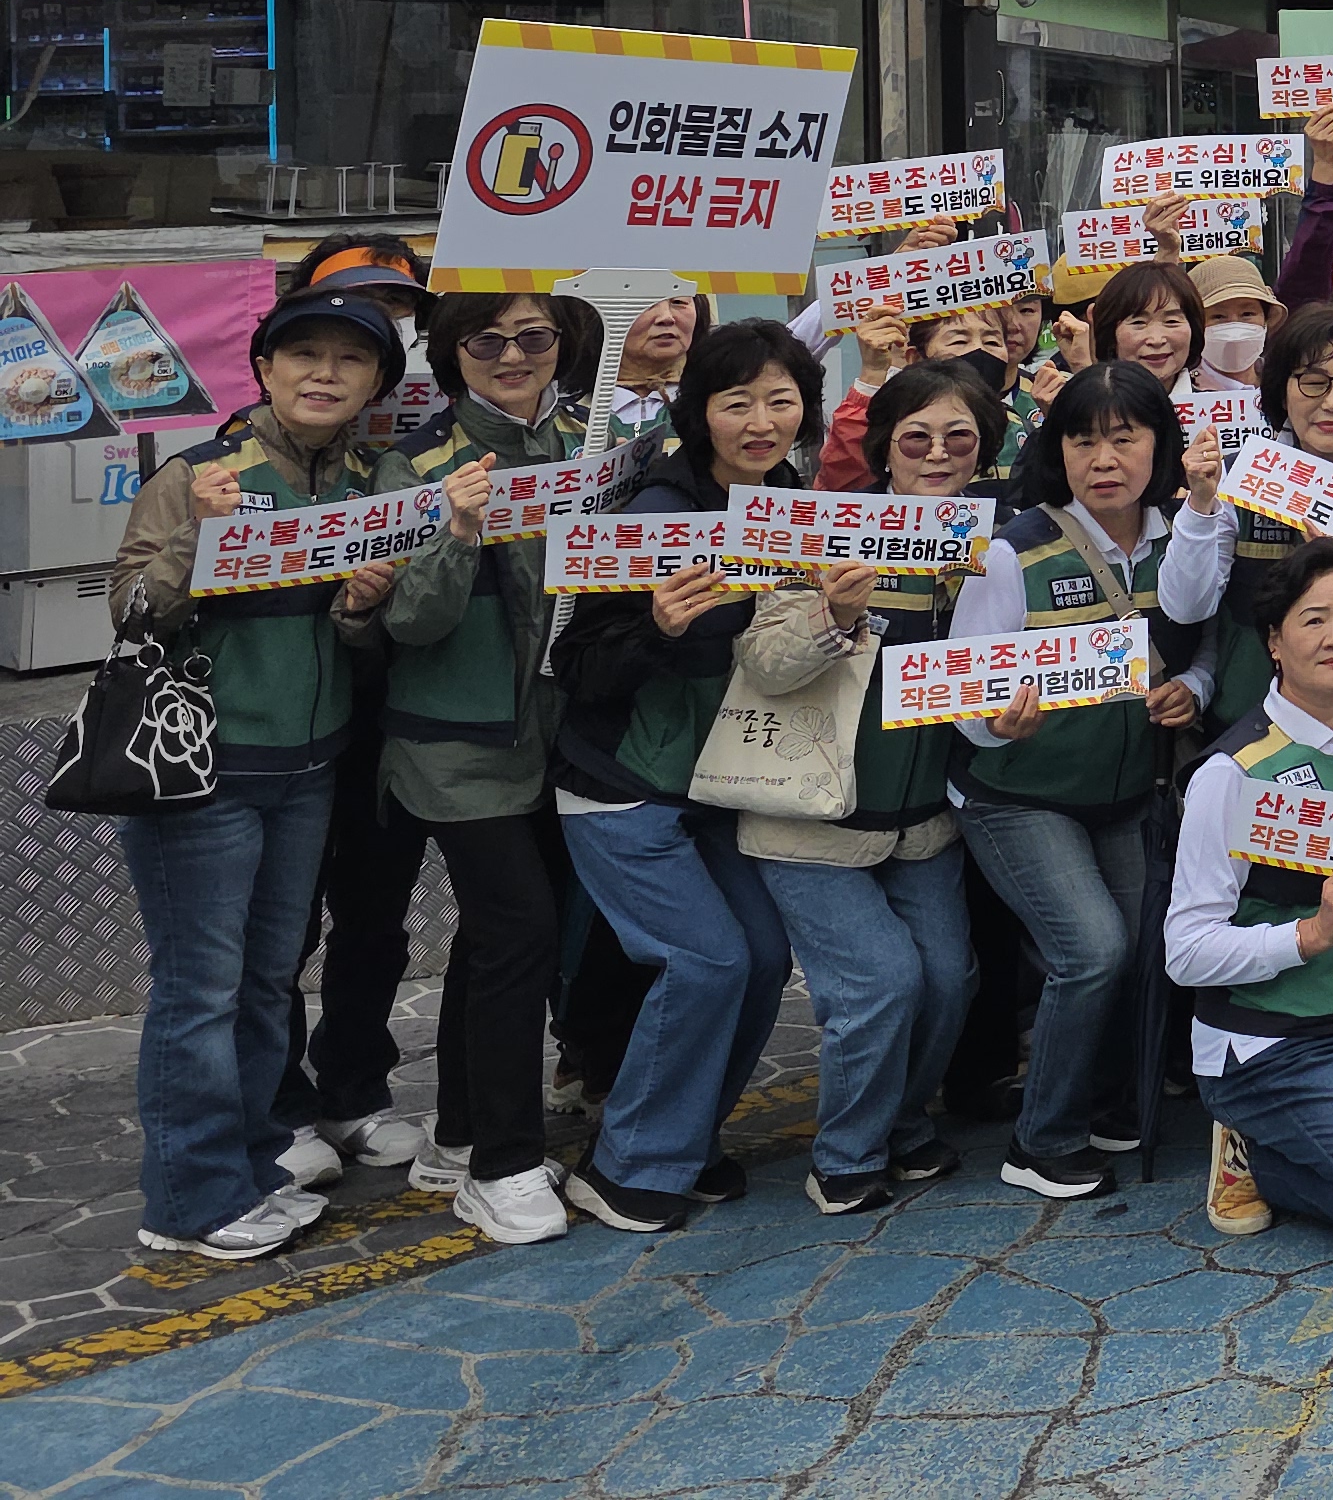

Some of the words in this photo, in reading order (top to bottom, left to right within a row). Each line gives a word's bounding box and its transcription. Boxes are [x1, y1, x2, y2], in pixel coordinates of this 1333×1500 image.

[1271, 88, 1309, 108] 작은
[605, 100, 753, 159] 인화물질
[754, 110, 829, 163] 소지
[1112, 175, 1150, 195] 작은
[1155, 171, 1195, 192] 불도
[1199, 168, 1290, 189] 위험해요!
[626, 173, 704, 227] 입산
[705, 176, 781, 230] 금지
[830, 200, 878, 224] 작은
[882, 194, 924, 219] 불도
[930, 185, 997, 213] 위험해요!
[1238, 472, 1286, 502] 작은
[741, 527, 794, 554] 작은
[799, 532, 851, 560] 불도
[857, 536, 972, 565] 위험해요!
[900, 684, 951, 711] 작은
[959, 679, 1012, 706] 불도
[742, 709, 782, 748] 존중
[1249, 823, 1299, 856] 작은
